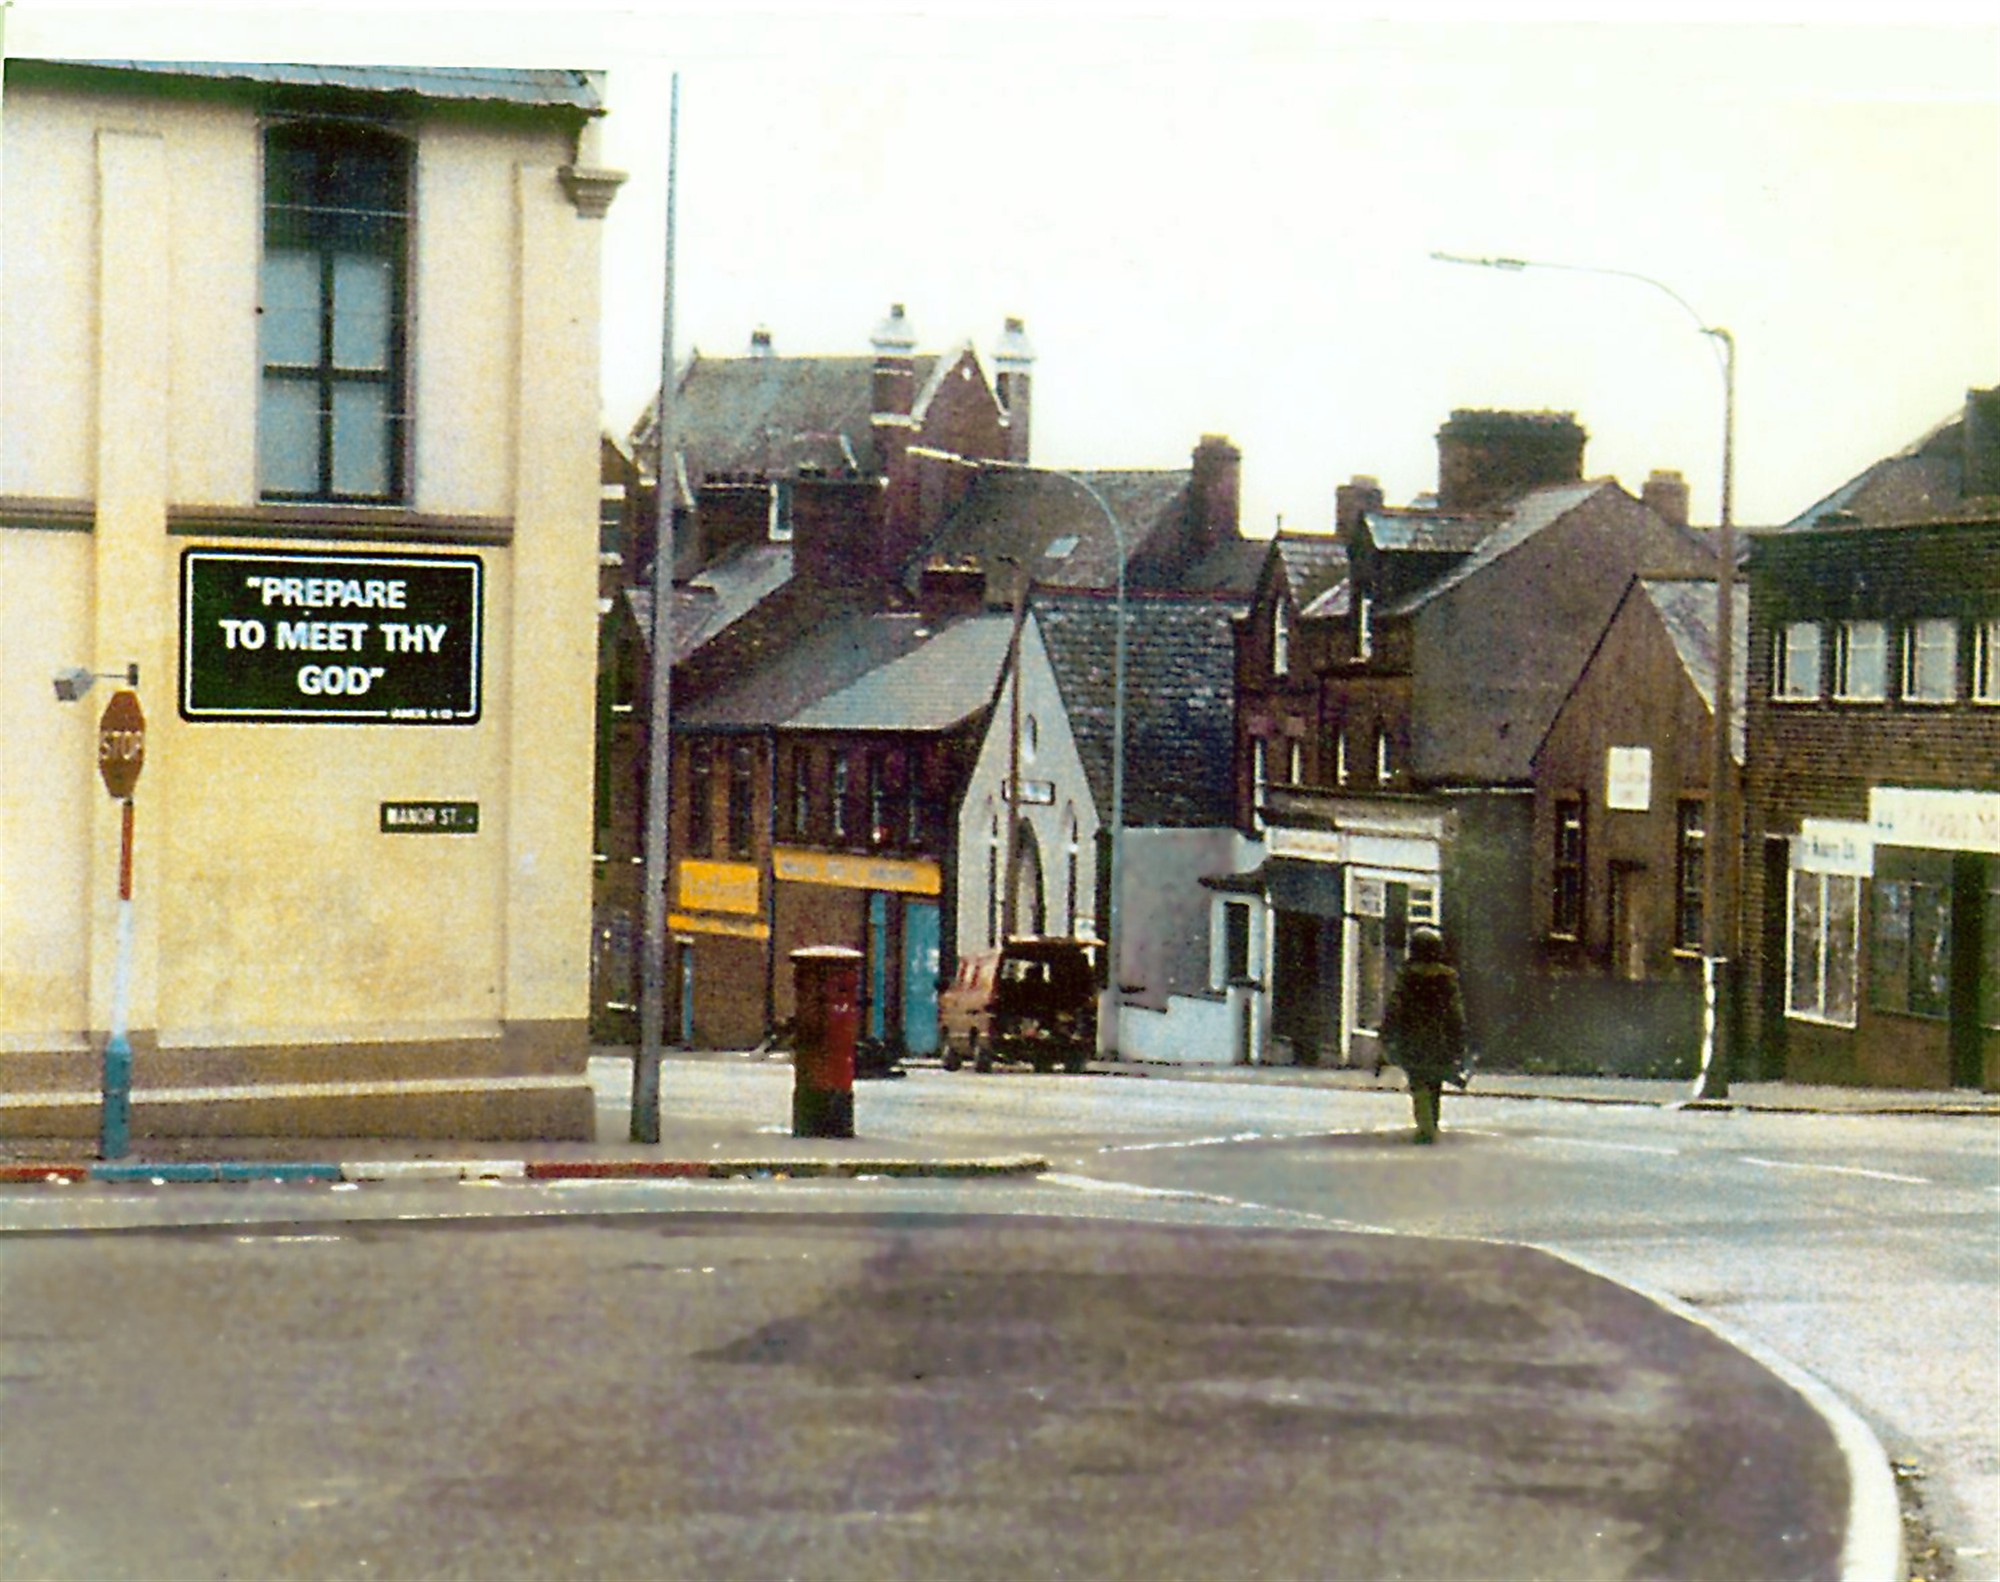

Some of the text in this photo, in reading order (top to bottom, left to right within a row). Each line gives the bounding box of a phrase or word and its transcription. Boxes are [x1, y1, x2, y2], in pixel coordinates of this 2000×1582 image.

[218, 619, 447, 652] TO MEET THY
[100, 730, 141, 760] STOP
